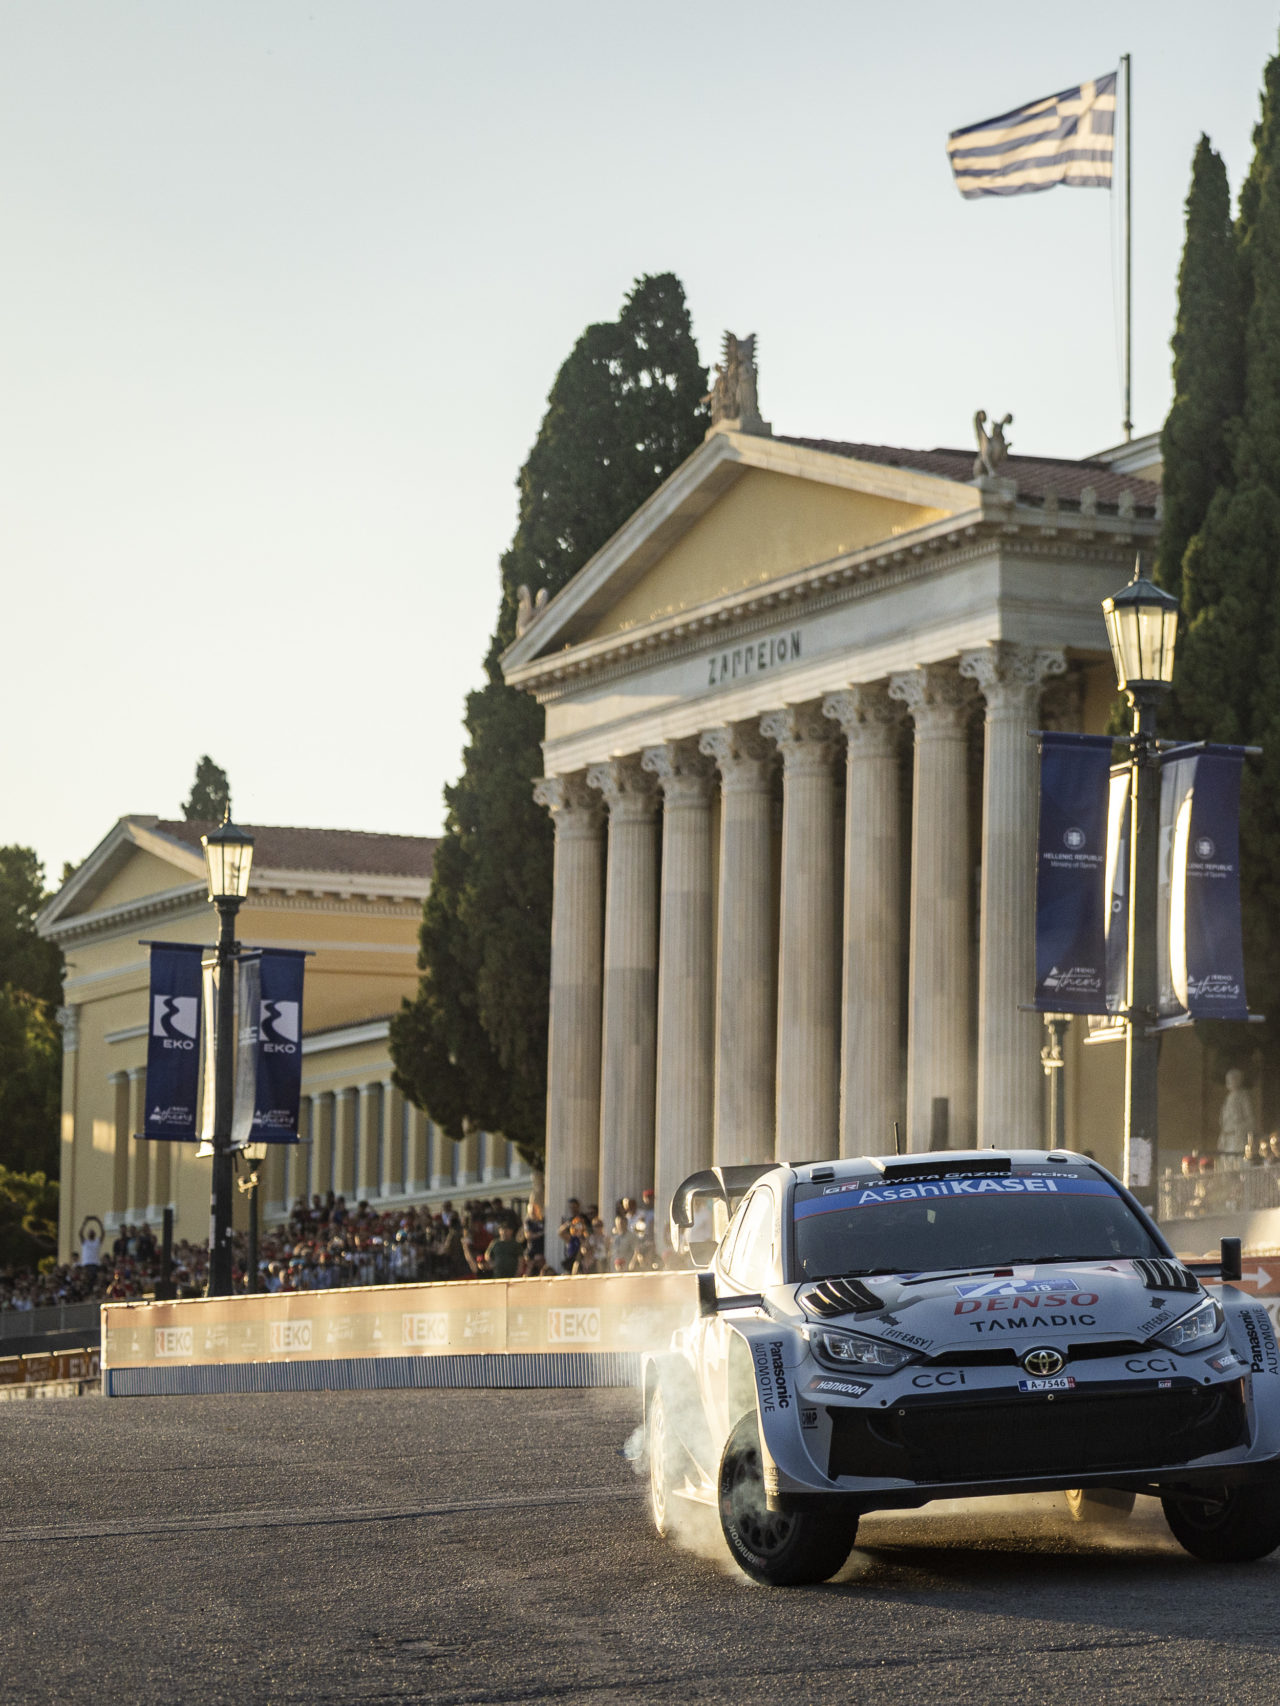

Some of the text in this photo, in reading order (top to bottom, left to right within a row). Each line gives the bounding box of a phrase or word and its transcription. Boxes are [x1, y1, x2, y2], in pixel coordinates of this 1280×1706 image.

[163, 1039, 194, 1050] EKO
[264, 1043, 296, 1054] EKO
[824, 1181, 859, 1195] GR
[864, 1174, 940, 1187] TOYOTA
[945, 1171, 1012, 1179] GAZOO
[1033, 1284, 1052, 1292] 18
[953, 1293, 1100, 1316] DENSO
[416, 1318, 447, 1340] EKO
[564, 1313, 600, 1337] EKO
[970, 1314, 1097, 1333] TAMADIC
[166, 1331, 193, 1353] EKO
[283, 1324, 312, 1347] EKO
[1239, 1310, 1264, 1374] Panasonic
[1253, 1308, 1279, 1375] AUTOMOTIVE
[754, 1343, 776, 1413] AUTOMOTIVE
[769, 1341, 792, 1409] Panasonic
[1031, 1380, 1067, 1389] A-7546
